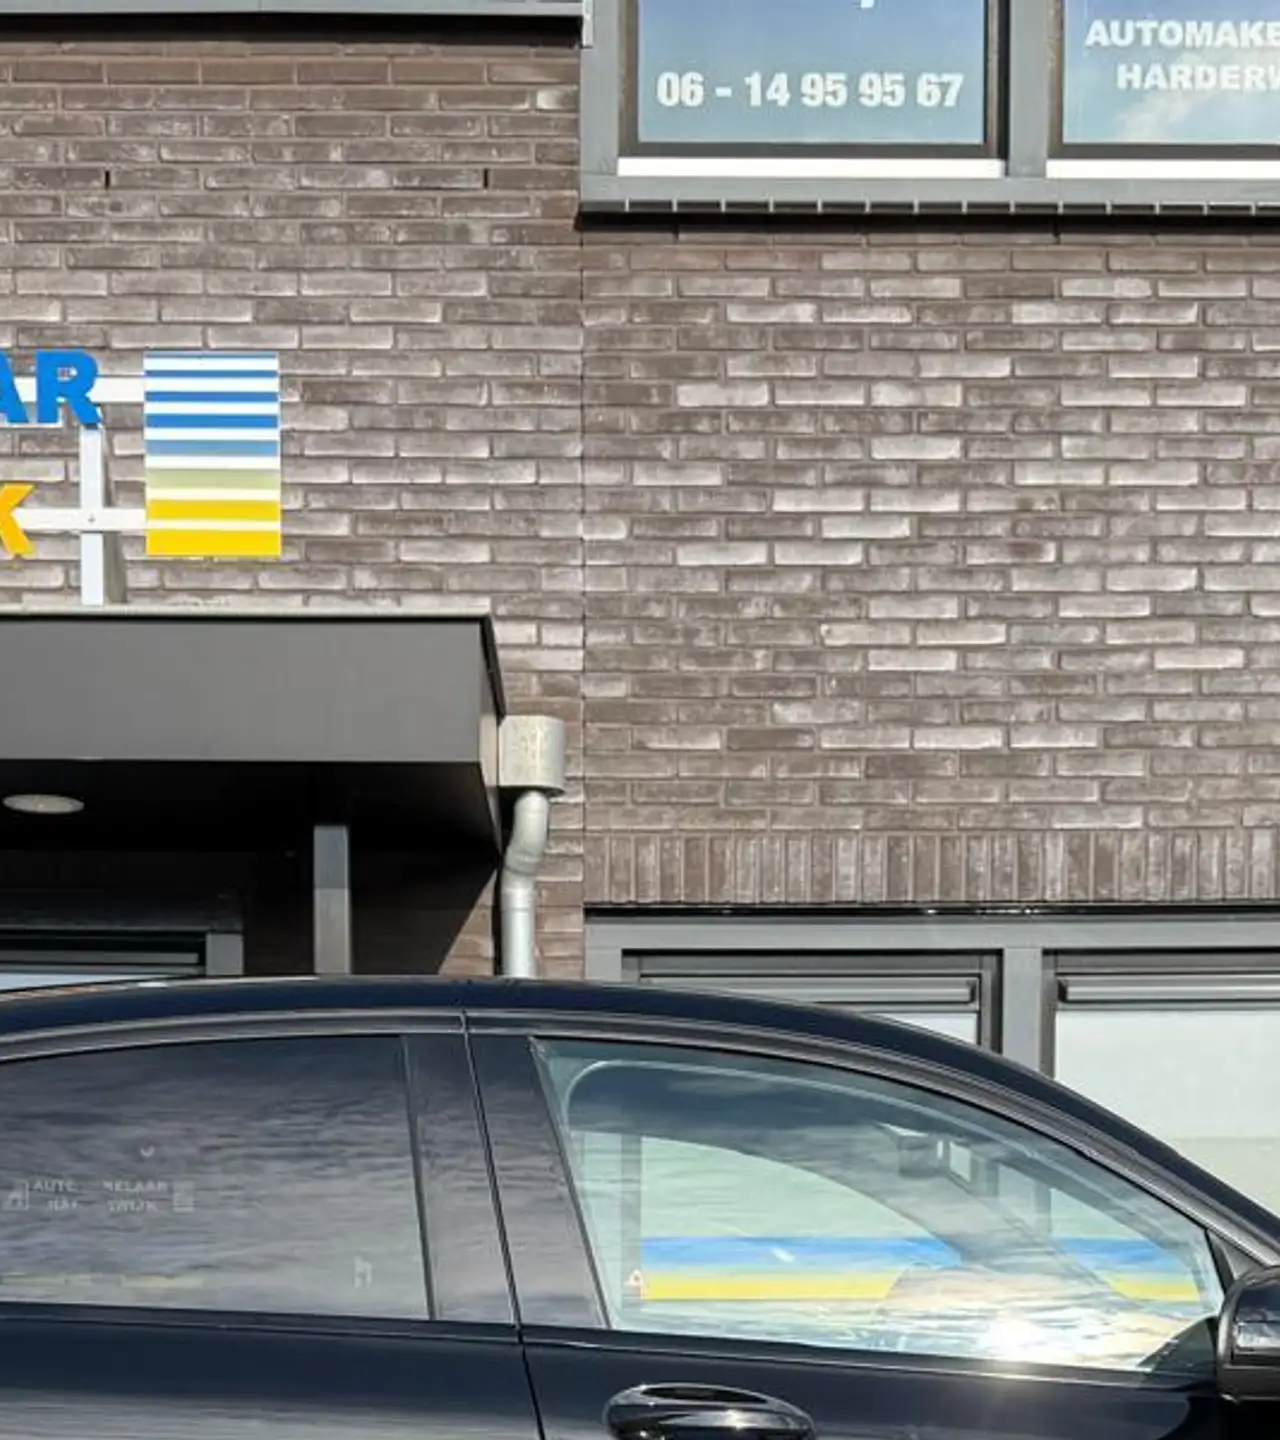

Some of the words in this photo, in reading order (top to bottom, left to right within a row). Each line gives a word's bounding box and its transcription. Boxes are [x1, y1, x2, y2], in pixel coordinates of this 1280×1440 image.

[656, 71, 705, 107] 06
[744, 71, 791, 107] 14
[800, 72, 849, 107] 95
[858, 72, 906, 107] 95
[916, 72, 965, 107] 67
